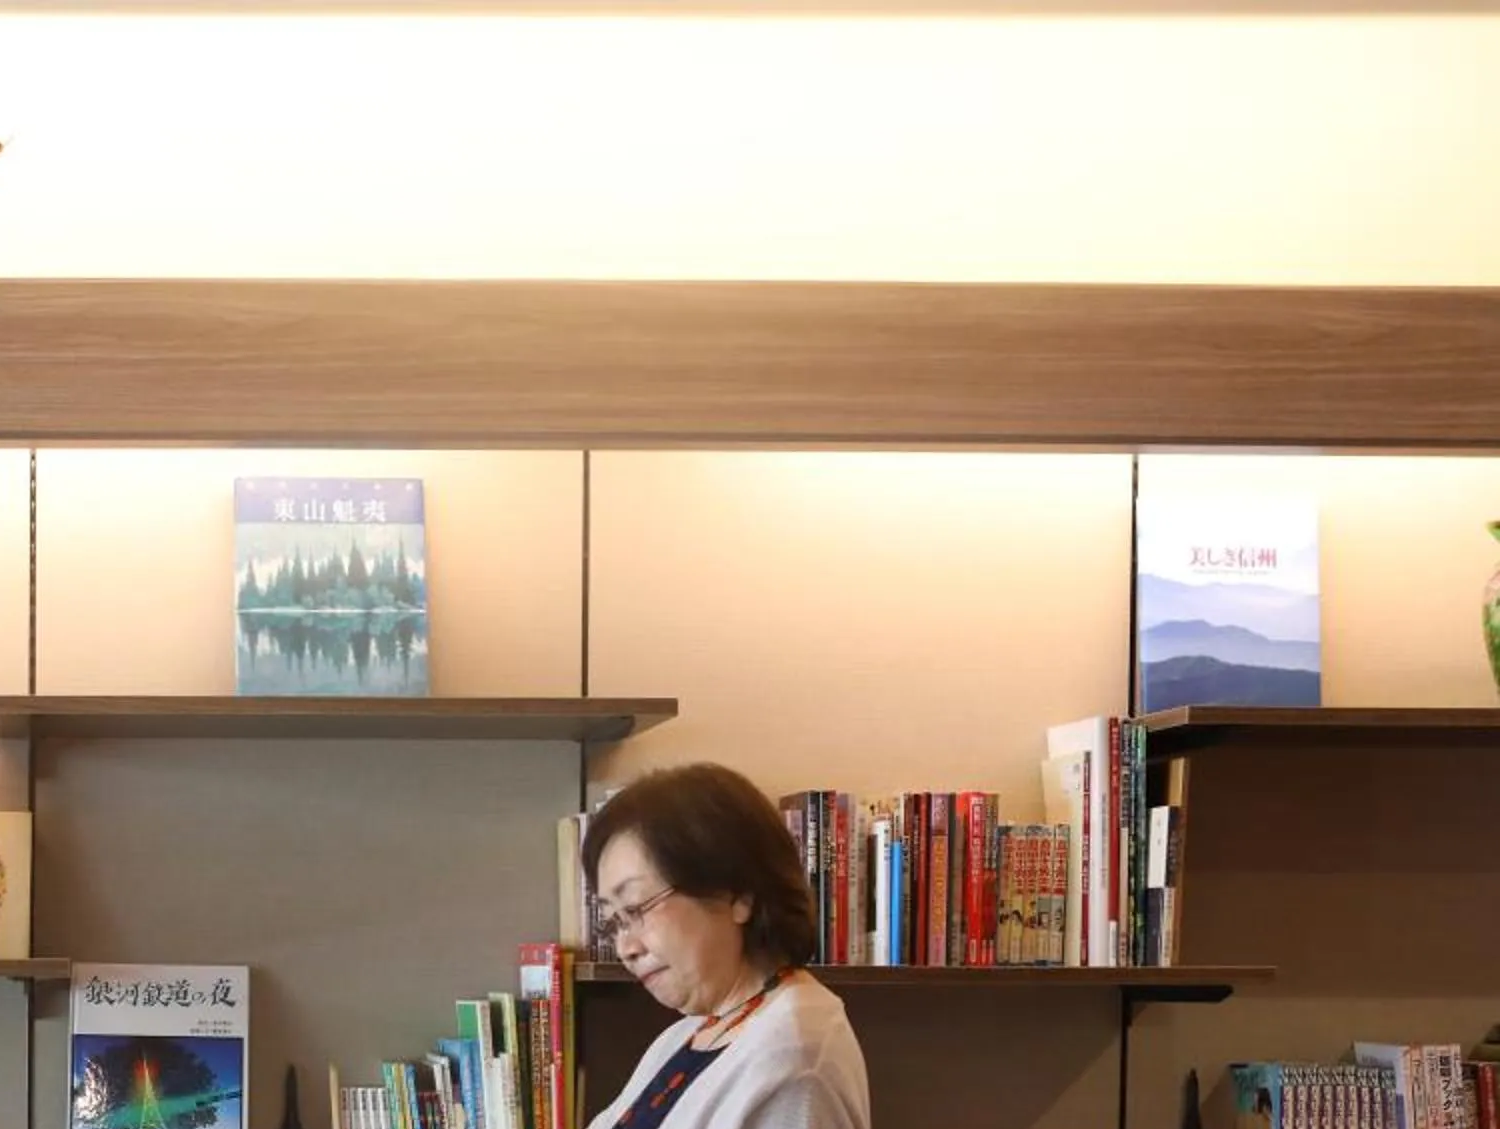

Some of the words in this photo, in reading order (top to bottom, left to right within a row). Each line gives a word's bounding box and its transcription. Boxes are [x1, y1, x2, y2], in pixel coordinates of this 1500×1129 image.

[274, 498, 386, 522] 東山魁夷
[1189, 547, 1278, 569] 美しき信州
[85, 975, 236, 1008] 銀河鉄道の夜
